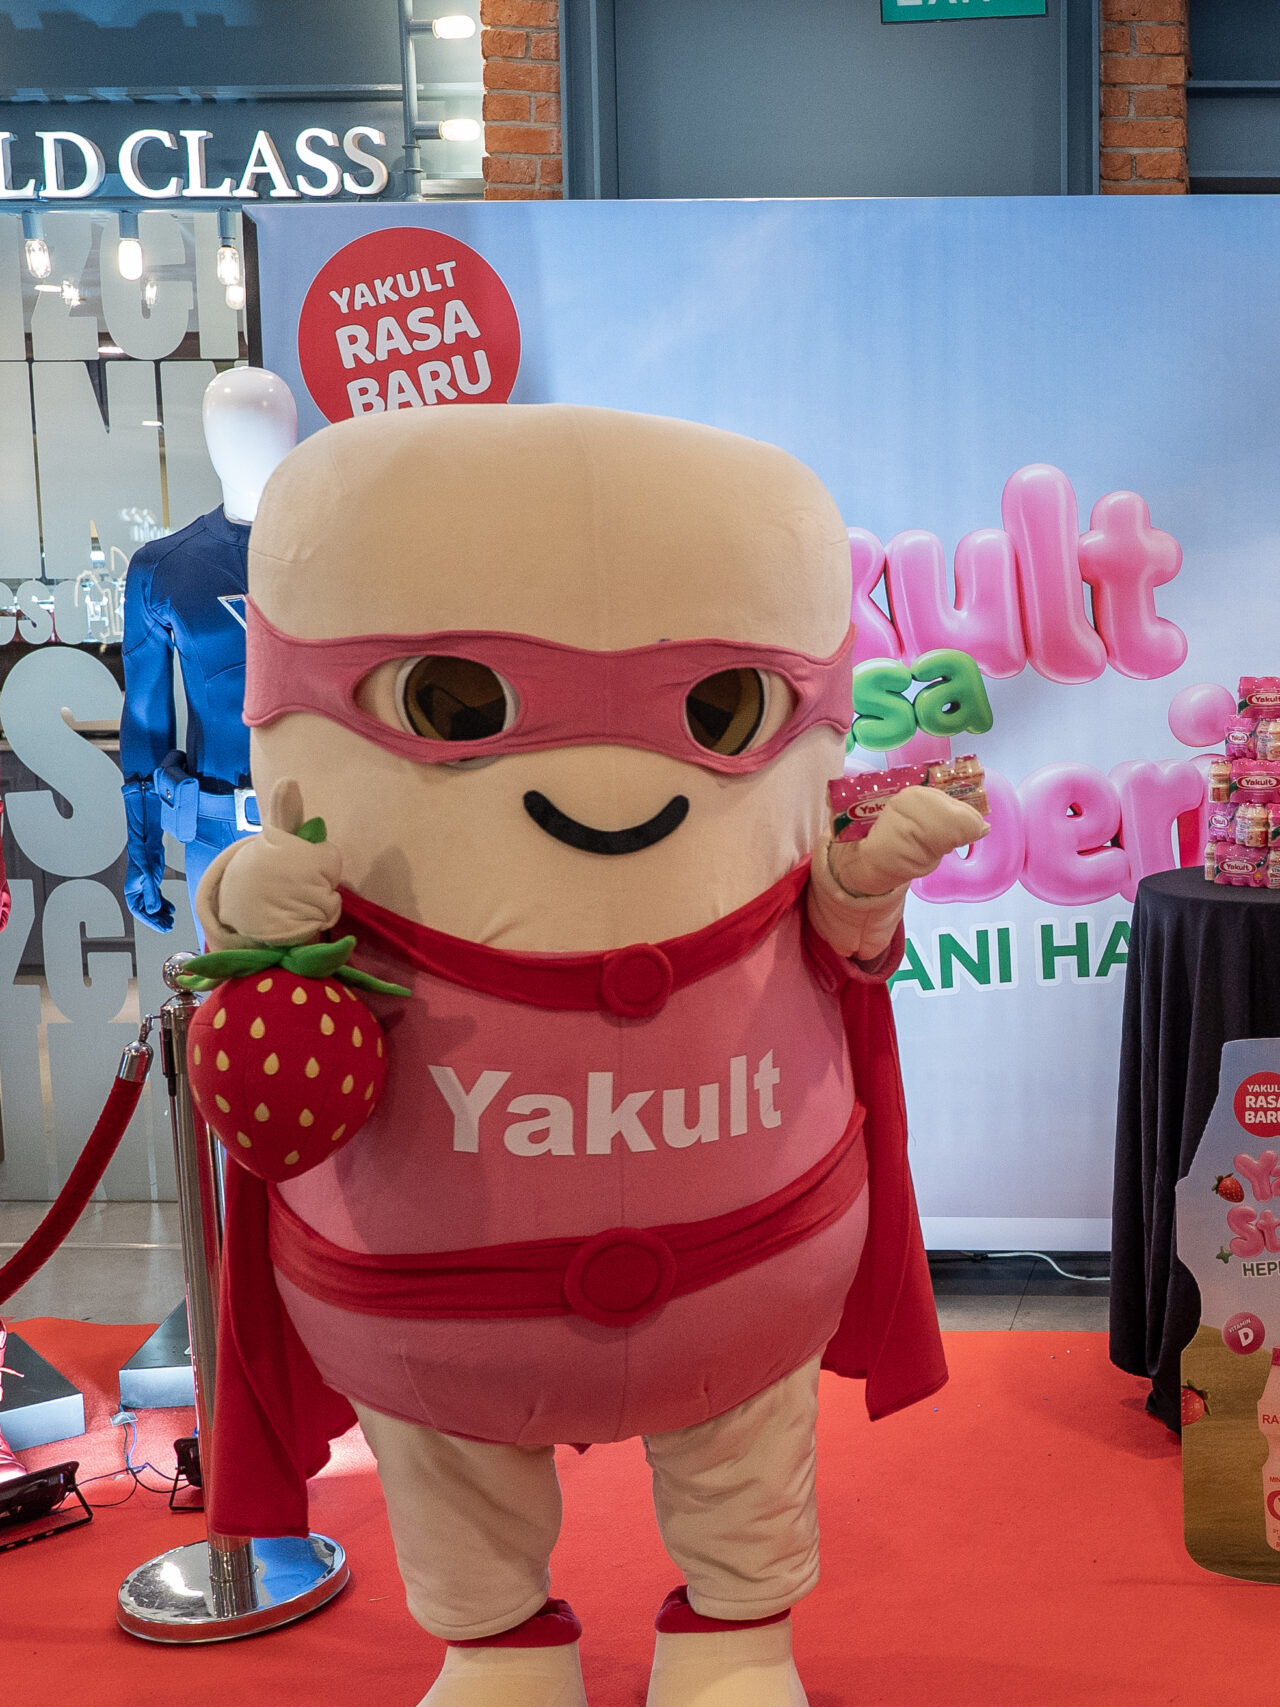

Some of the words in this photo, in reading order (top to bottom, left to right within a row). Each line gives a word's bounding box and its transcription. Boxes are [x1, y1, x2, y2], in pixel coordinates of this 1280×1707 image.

[118, 126, 388, 198] CLASS
[329, 260, 457, 314] YAKULT
[334, 299, 482, 369] RASA
[346, 349, 493, 417] BARU
[846, 648, 994, 755] sa
[860, 803, 886, 815] Yak
[1225, 862, 1249, 871] Yakult
[427, 1048, 782, 1157] Yakult
[1229, 1318, 1251, 1333] VITAMIN
[1238, 1327, 1254, 1347] D
